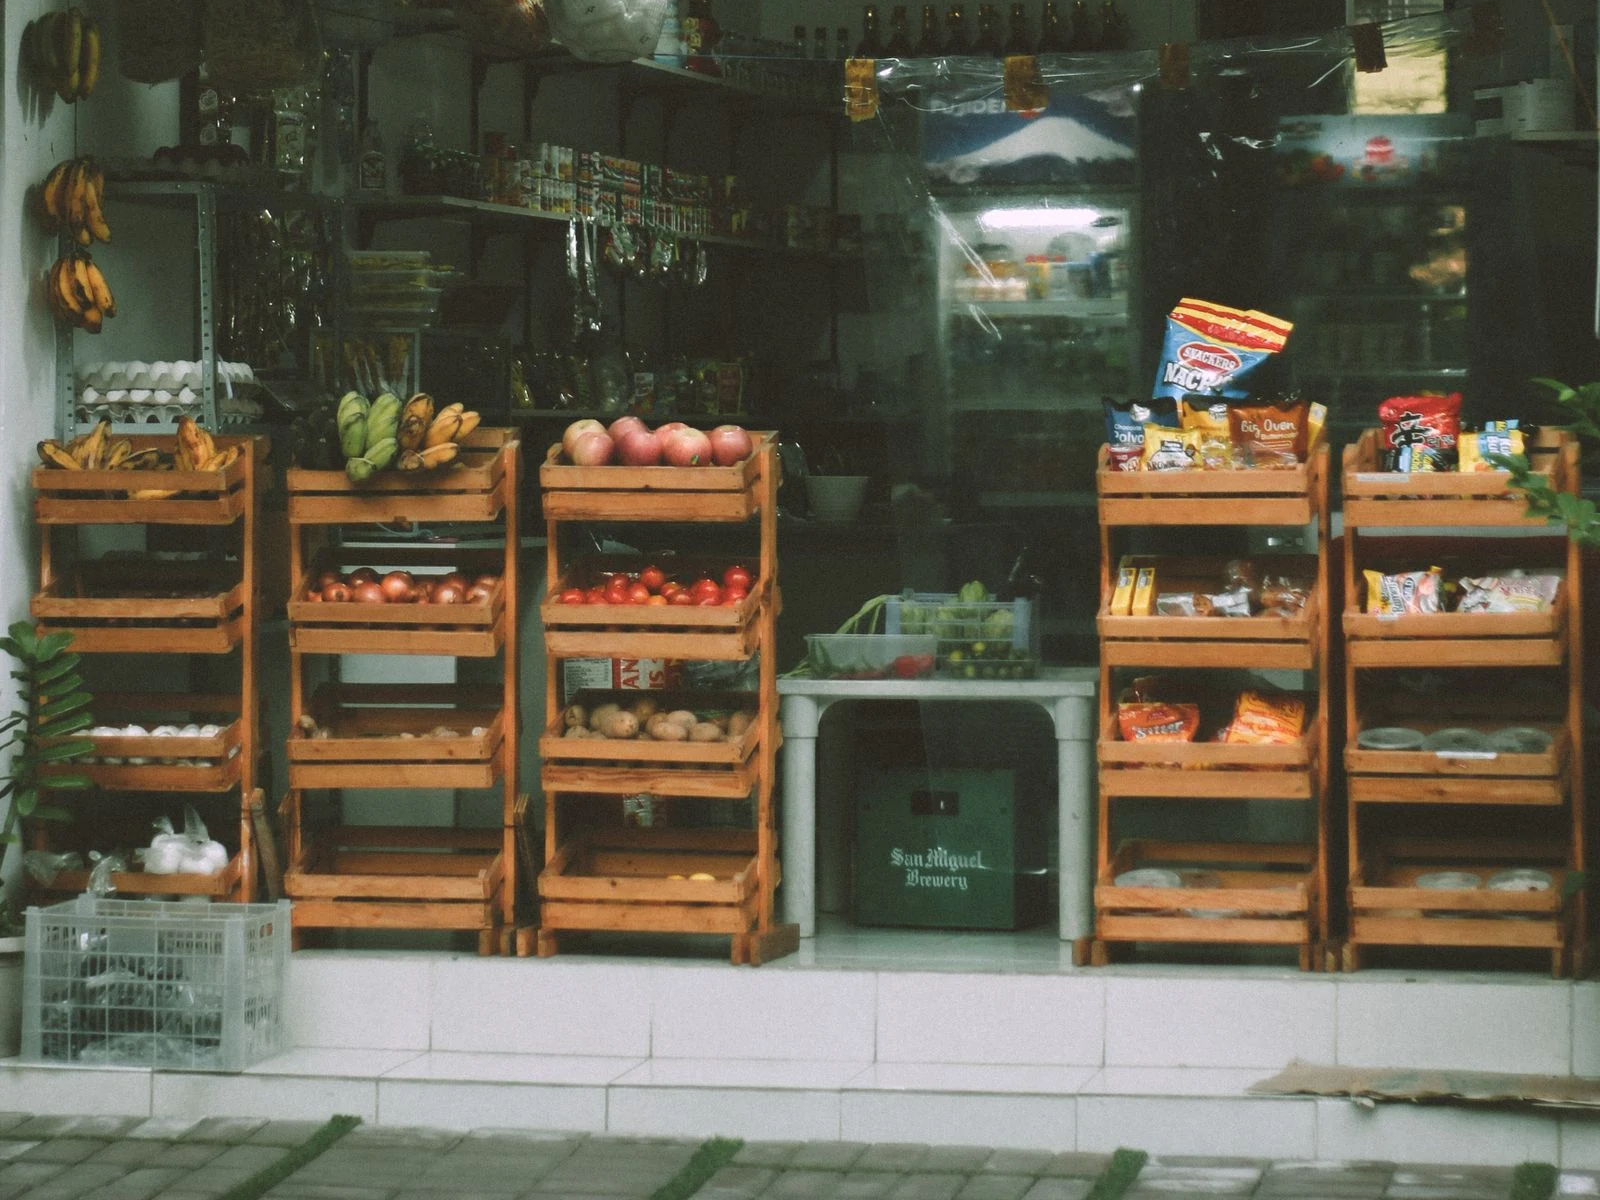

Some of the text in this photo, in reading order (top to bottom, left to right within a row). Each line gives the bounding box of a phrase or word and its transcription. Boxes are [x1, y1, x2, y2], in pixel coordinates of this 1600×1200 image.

[1241, 419, 1260, 439] Big
[1263, 418, 1297, 432] Oven
[890, 846, 985, 872] San Miguel
[905, 868, 969, 891] Brewery
